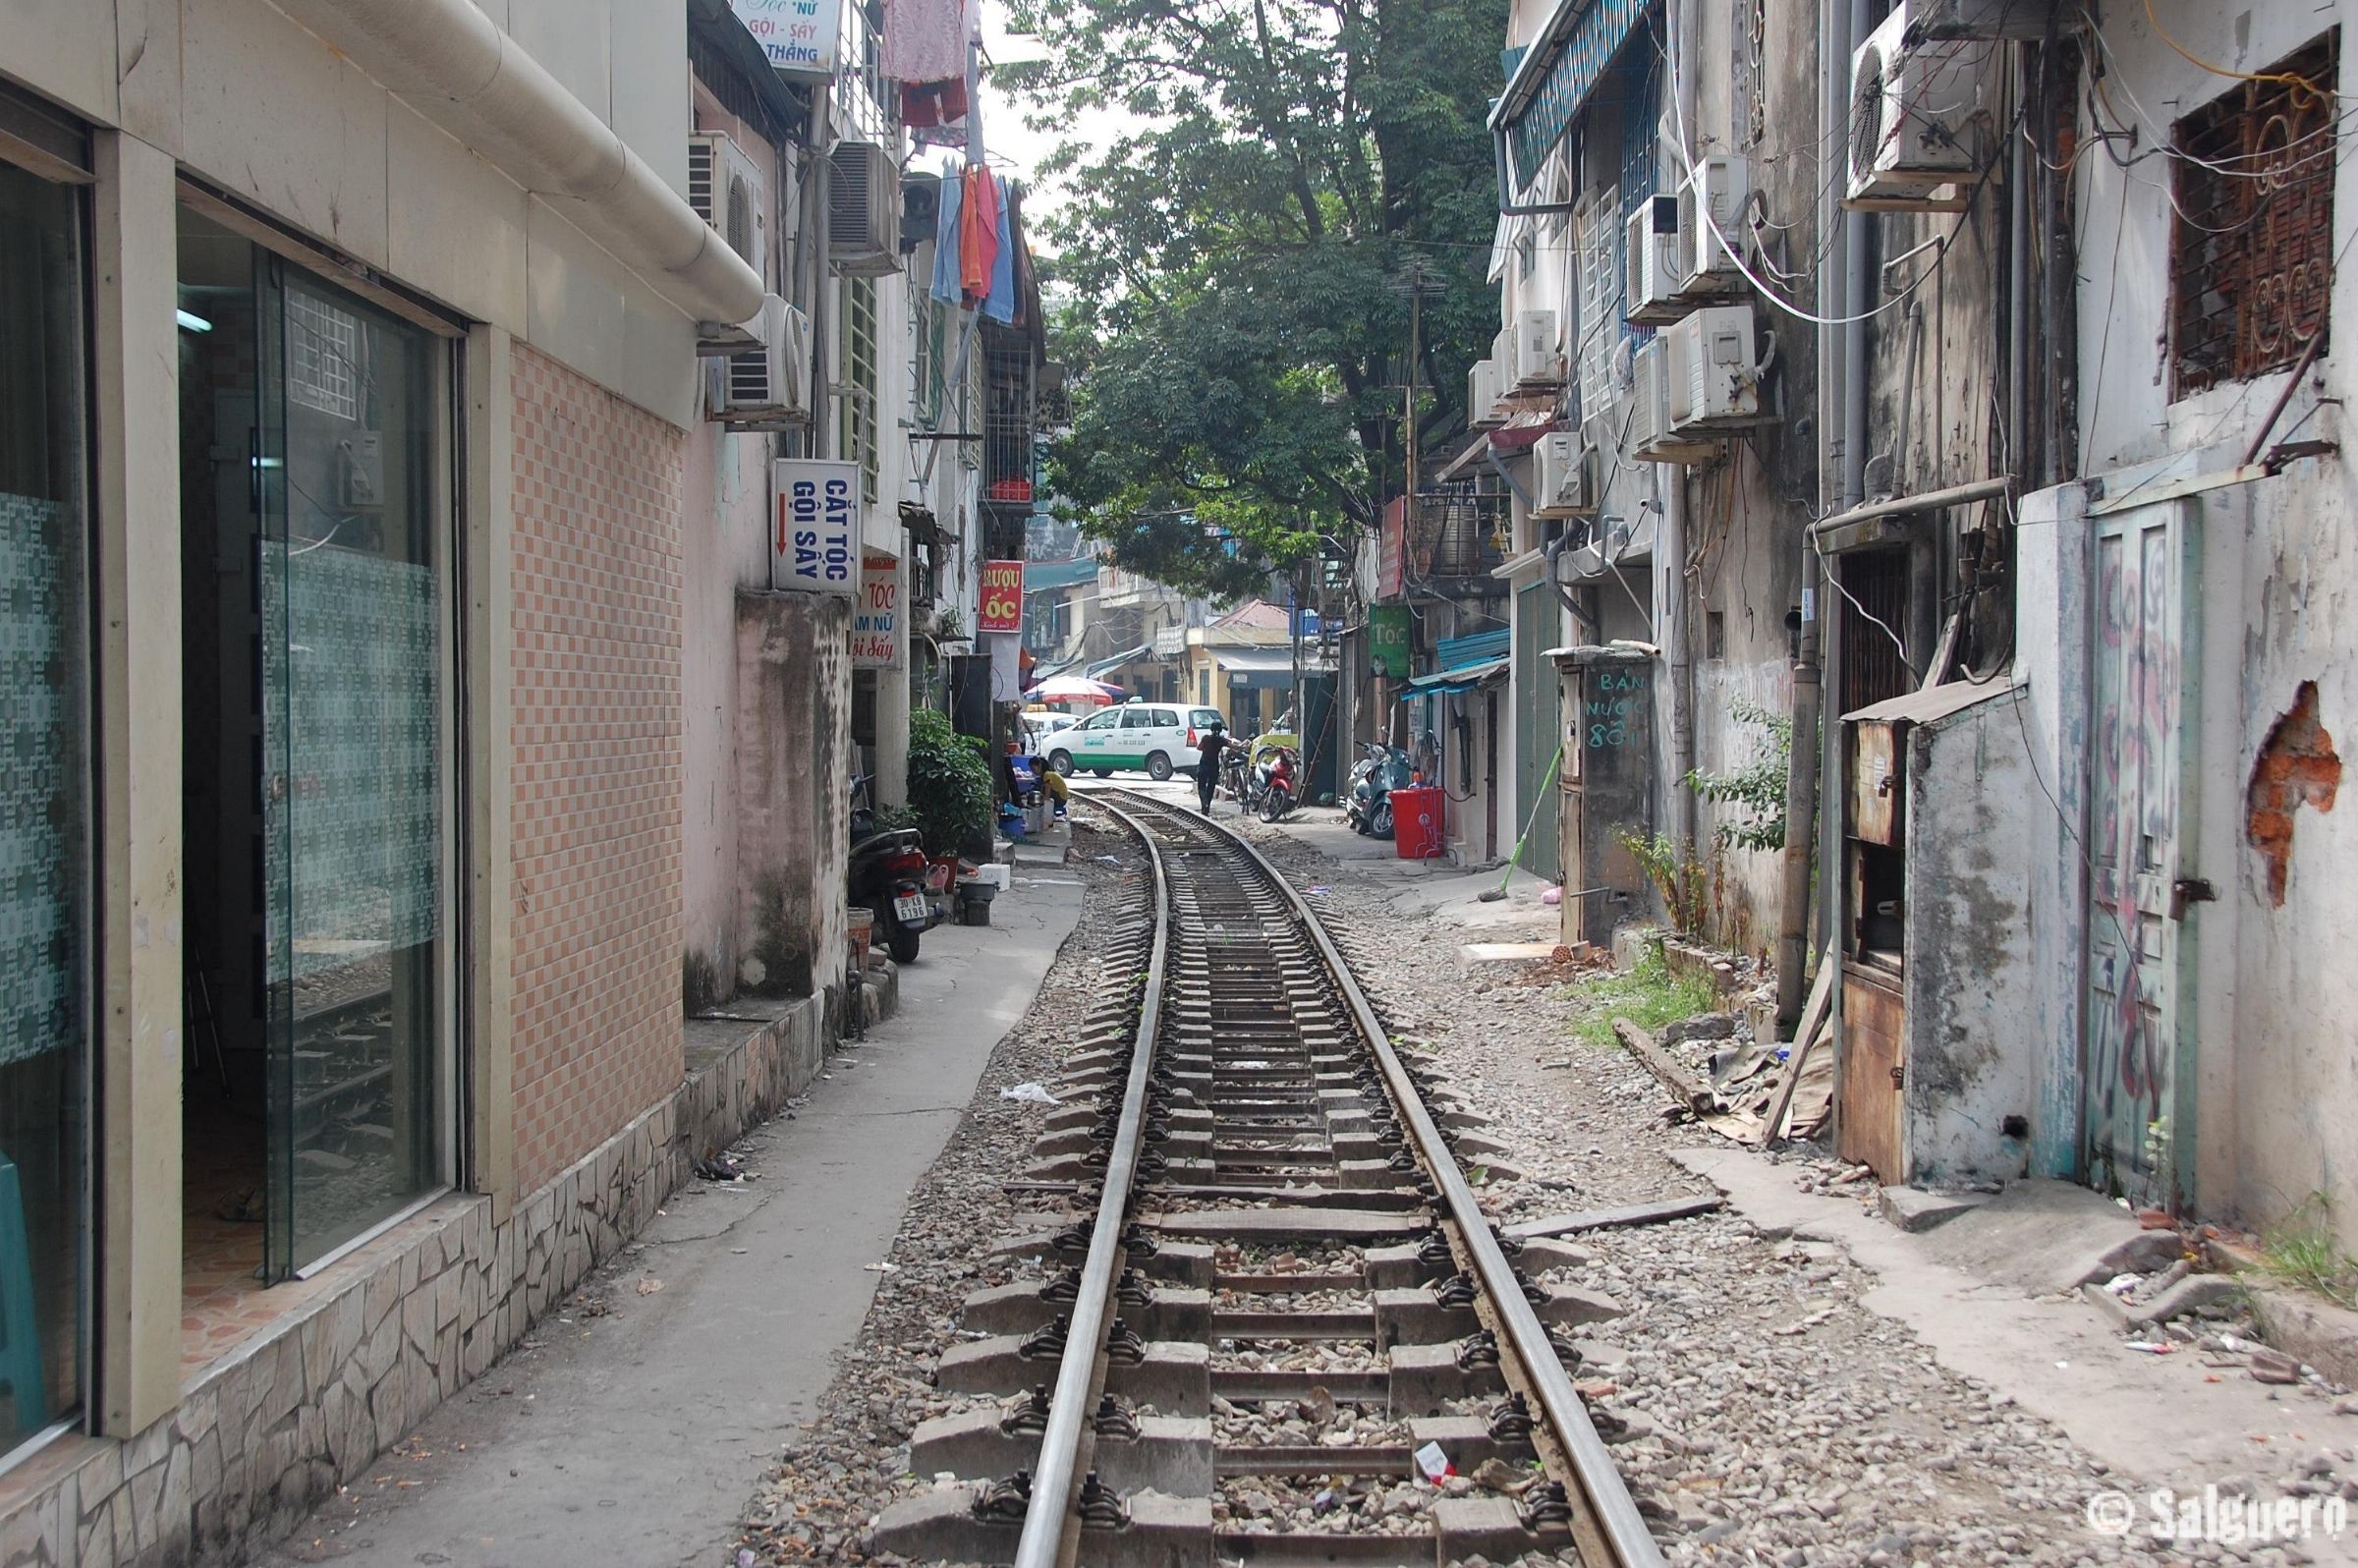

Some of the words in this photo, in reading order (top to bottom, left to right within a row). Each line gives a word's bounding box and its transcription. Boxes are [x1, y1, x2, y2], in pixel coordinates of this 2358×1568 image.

[749, 18, 776, 37] GỘI
[789, 20, 817, 39] SẤY
[766, 39, 817, 63] THẲNG
[789, 480, 821, 523] GỘI
[825, 479, 857, 527] CẮT
[795, 531, 826, 580] SẤY
[825, 533, 854, 581] TÓC
[869, 577, 895, 609] TÓC
[874, 612, 894, 631] NỮ
[1600, 669, 1645, 692] BÁN
